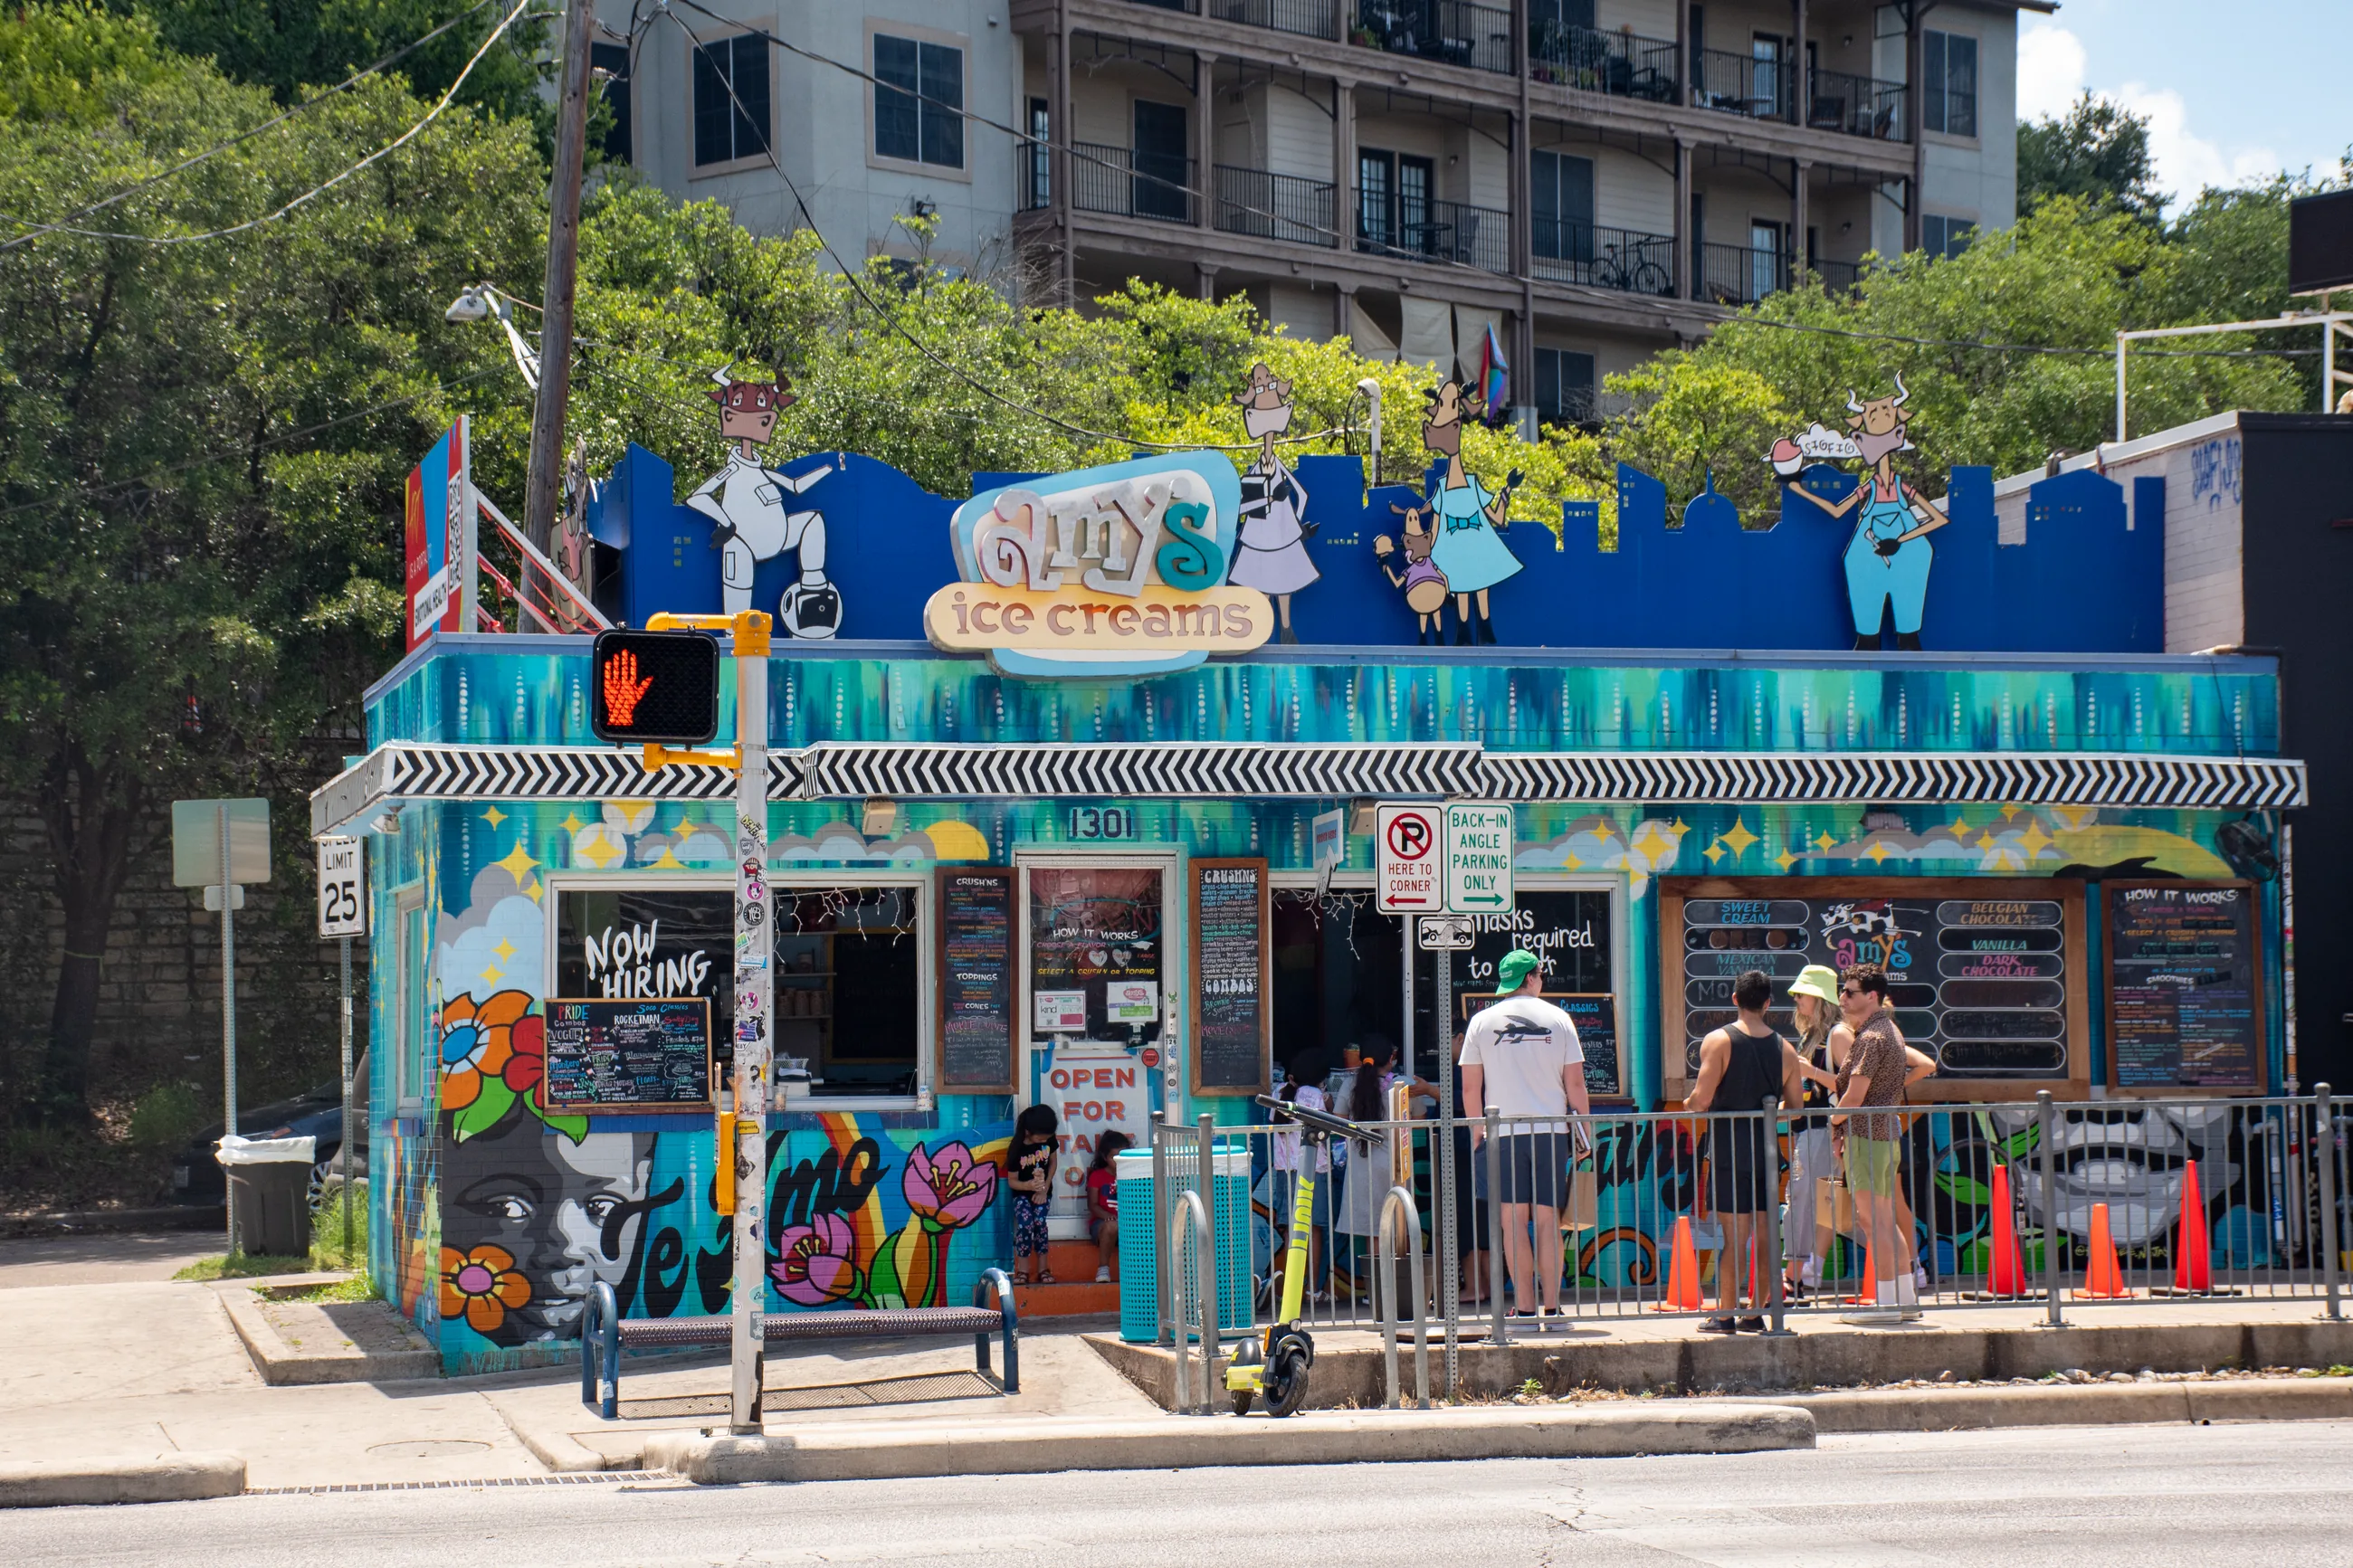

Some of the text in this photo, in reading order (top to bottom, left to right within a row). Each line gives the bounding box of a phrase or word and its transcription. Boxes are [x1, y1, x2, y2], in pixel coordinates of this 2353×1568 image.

[951, 591, 1253, 639] ice creams
[1072, 808, 1132, 838] 1301
[1460, 834, 1500, 849] ANGLE
[326, 851, 353, 870] LIMIT
[1453, 854, 1508, 870] PARKING
[1388, 863, 1432, 875] HERE TO
[957, 878, 998, 887] CRUSH'NS
[1390, 880, 1431, 891] CORNER
[1463, 875, 1497, 890] ONLY
[325, 880, 357, 923] 25
[2125, 889, 2158, 902] HOW
[2164, 889, 2179, 901] IT
[1721, 902, 1770, 912] SWEET
[1971, 904, 2028, 913] BELGIAN
[1721, 914, 1770, 924] CREAM
[1053, 928, 1138, 940] HOW IT WORKS
[1512, 920, 1595, 962] required
[1972, 940, 2027, 950] VANILLA
[586, 919, 658, 980] NOW
[1717, 955, 1777, 965] MEXICAN
[1982, 955, 2022, 966] DARK
[1468, 956, 1492, 978] to
[1962, 966, 2038, 976] CHOCOLATE
[603, 950, 711, 999] HIRING
[957, 973, 998, 981] TOPPINGS
[2146, 974, 2194, 984] SMOOTHIES
[1205, 978, 1253, 993] COMBOS
[558, 1004, 590, 1020] PRIDE
[660, 1003, 689, 1013] Classics
[1041, 1006, 1057, 1014] kind
[614, 1013, 660, 1025] ROCKETMAN
[551, 1030, 580, 1041] VOGUE
[1050, 1068, 1135, 1089] OPEN
[1063, 1100, 1126, 1121] FOR
